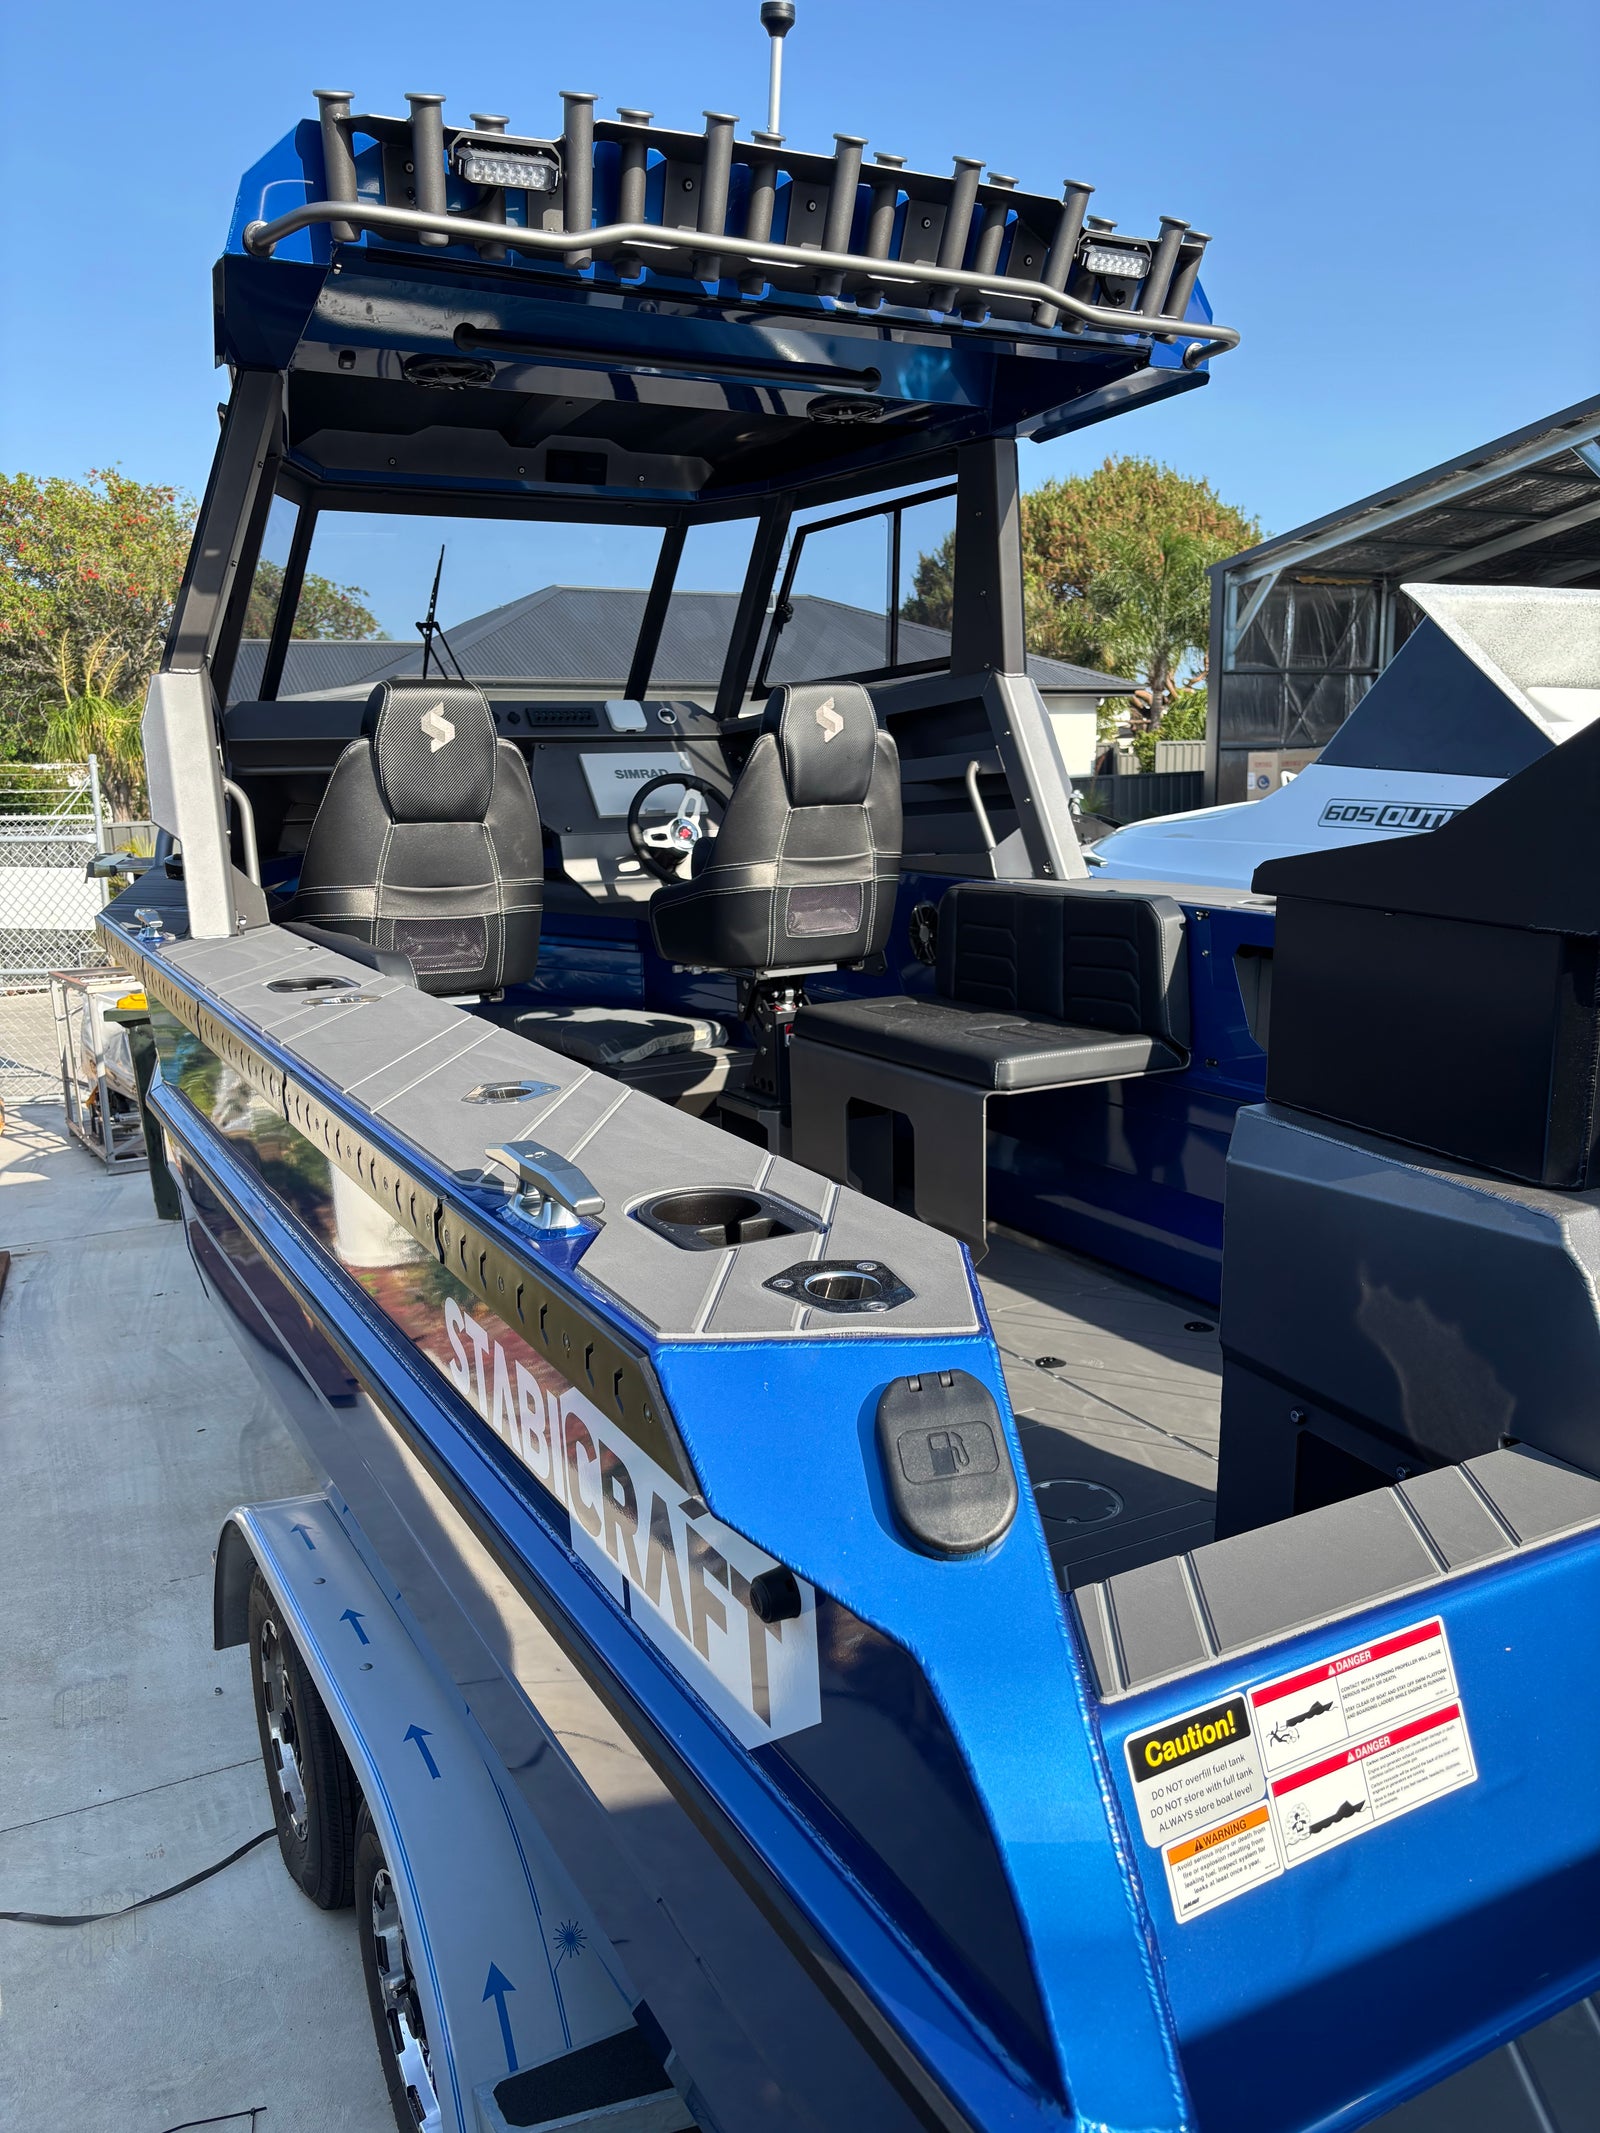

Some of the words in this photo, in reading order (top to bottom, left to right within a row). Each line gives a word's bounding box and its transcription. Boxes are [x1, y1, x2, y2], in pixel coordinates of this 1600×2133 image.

[614, 768, 669, 779] SIMRAD
[1324, 805, 1378, 822] 605
[444, 1297, 783, 1728] STABICRAFT
[1336, 1651, 1371, 1671] DANGER
[1145, 1710, 1236, 1767] Caution!
[1355, 1736, 1390, 1758] DANGER
[1150, 1806, 1164, 1819] DO
[1165, 1797, 1182, 1812] NOT
[1184, 1790, 1205, 1804] store
[1205, 1781, 1222, 1794] with
[1223, 1774, 1235, 1787] full
[1236, 1767, 1254, 1781] tank
[1151, 1788, 1164, 1801] DO
[1166, 1779, 1183, 1794] NOT
[1185, 1767, 1212, 1786] overfill
[1212, 1761, 1228, 1774] fuel
[1228, 1754, 1246, 1767] tank
[1159, 1810, 1194, 1833] ALWAYS
[1194, 1802, 1215, 1817] store
[1215, 1792, 1234, 1807] boat
[1234, 1783, 1252, 1798] level
[1177, 1860, 1193, 1872] Avoid
[1194, 1851, 1214, 1864] serious
[1215, 1844, 1230, 1854] injury
[1238, 1833, 1253, 1843] death
[1253, 1827, 1266, 1836] from
[1203, 1819, 1247, 1846] WARNING
[1183, 1871, 1192, 1879] fire
[1200, 1855, 1226, 1871] explosion
[1227, 1843, 1251, 1858] resulting
[1251, 1837, 1264, 1847] from
[1184, 1876, 1205, 1888] leaking
[1218, 1859, 1238, 1872] Inspect
[1239, 1850, 1257, 1863] system
[1258, 1846, 1266, 1854] for
[1194, 1884, 1209, 1894] leaks
[1215, 1873, 1229, 1883] least
[1230, 1867, 1243, 1877] once
